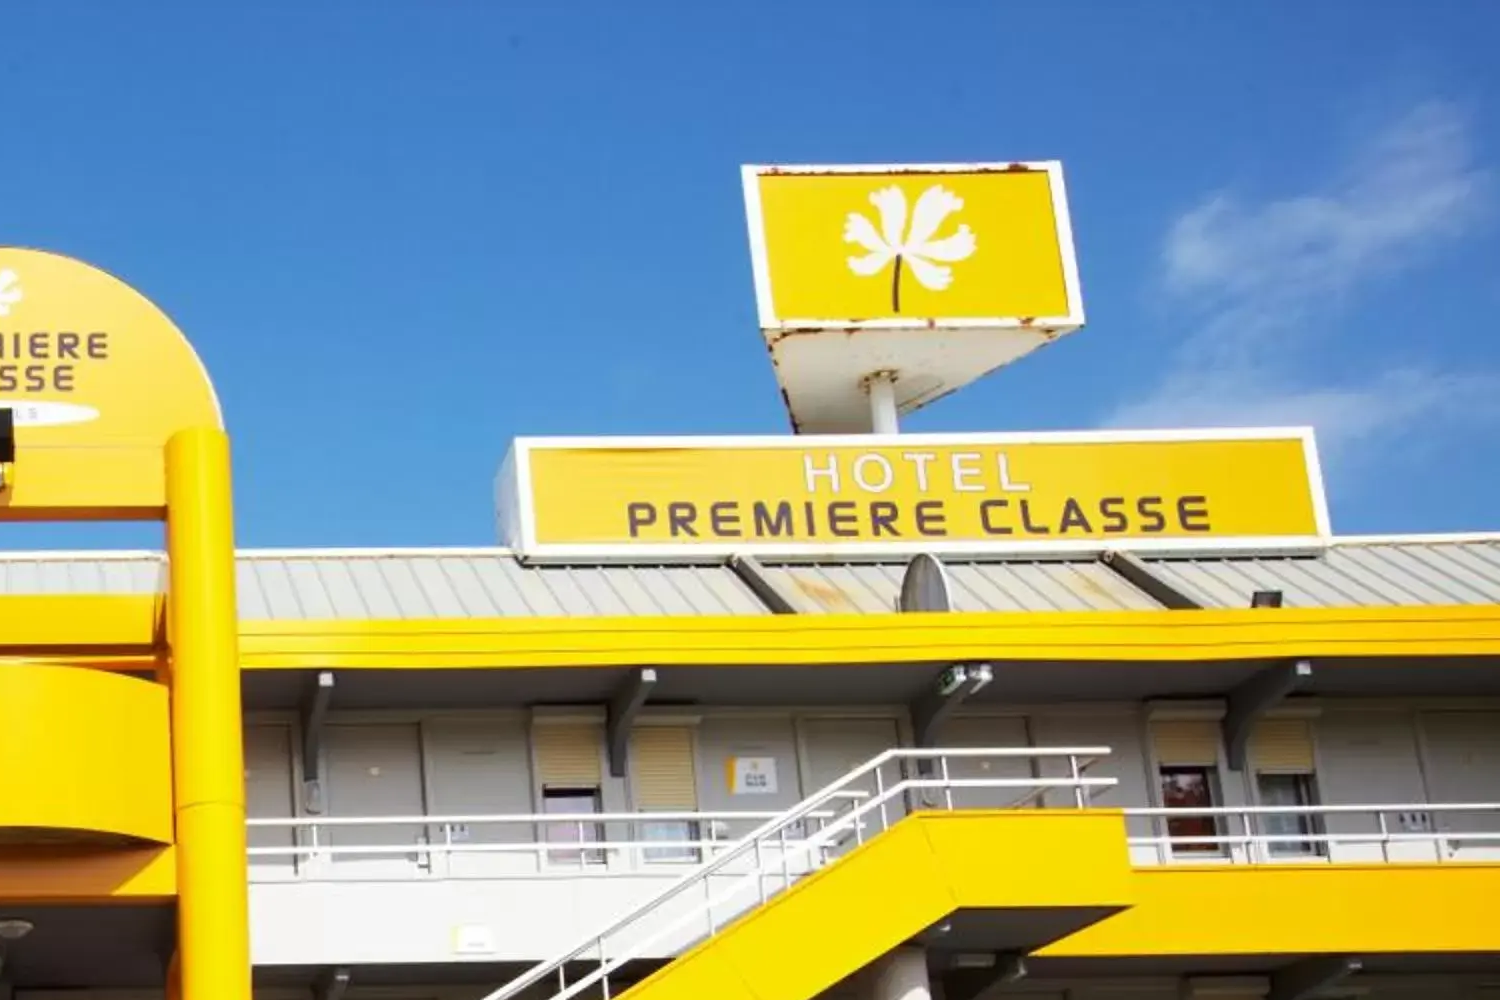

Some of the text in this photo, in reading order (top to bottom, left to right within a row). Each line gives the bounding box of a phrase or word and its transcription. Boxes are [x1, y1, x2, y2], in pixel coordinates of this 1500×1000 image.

[803, 452, 1032, 494] HOTEL
[627, 494, 1211, 538] PREMIERE CLASSE
